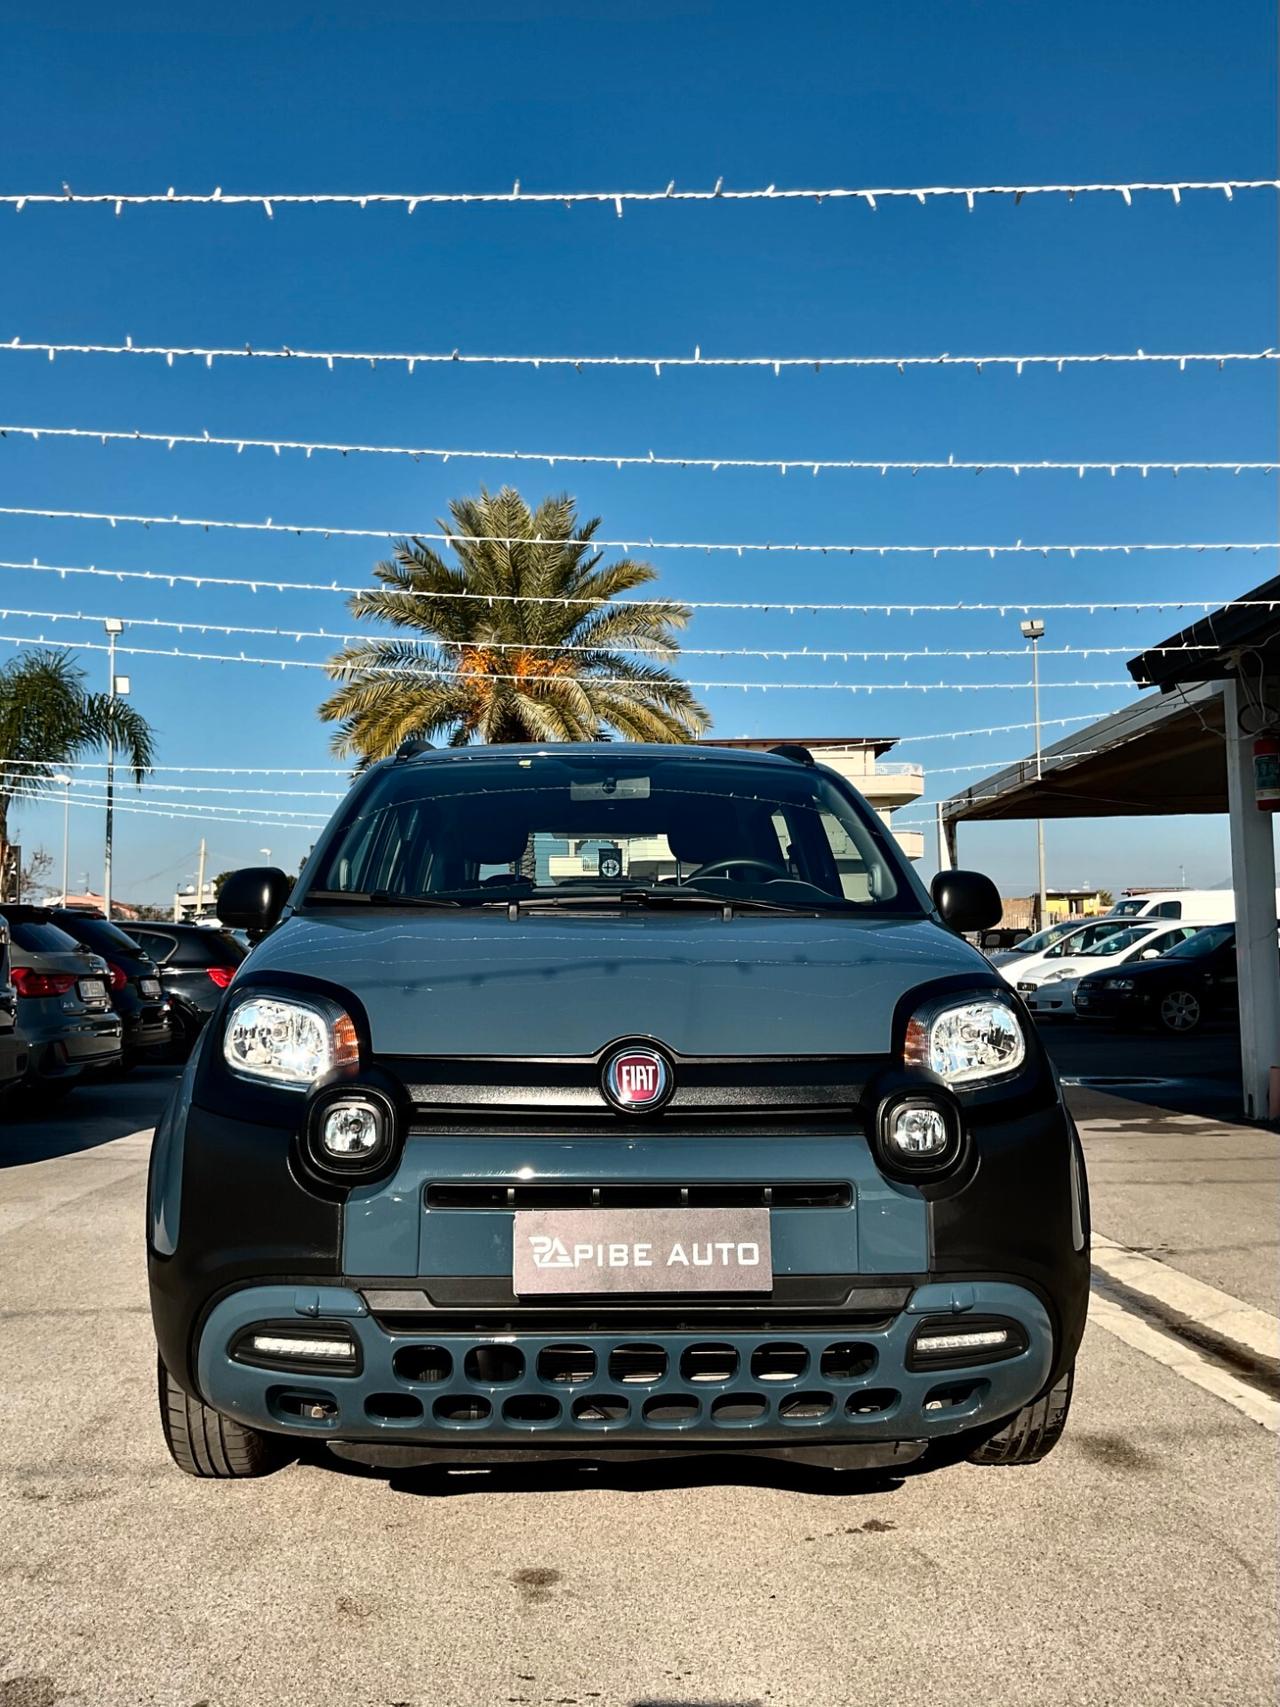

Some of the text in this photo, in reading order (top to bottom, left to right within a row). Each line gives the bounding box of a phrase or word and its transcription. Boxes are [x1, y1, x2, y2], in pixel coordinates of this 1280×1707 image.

[621, 1065, 656, 1091] FIAT
[574, 1244, 653, 1267] PIBE
[666, 1242, 760, 1266] AUTO
